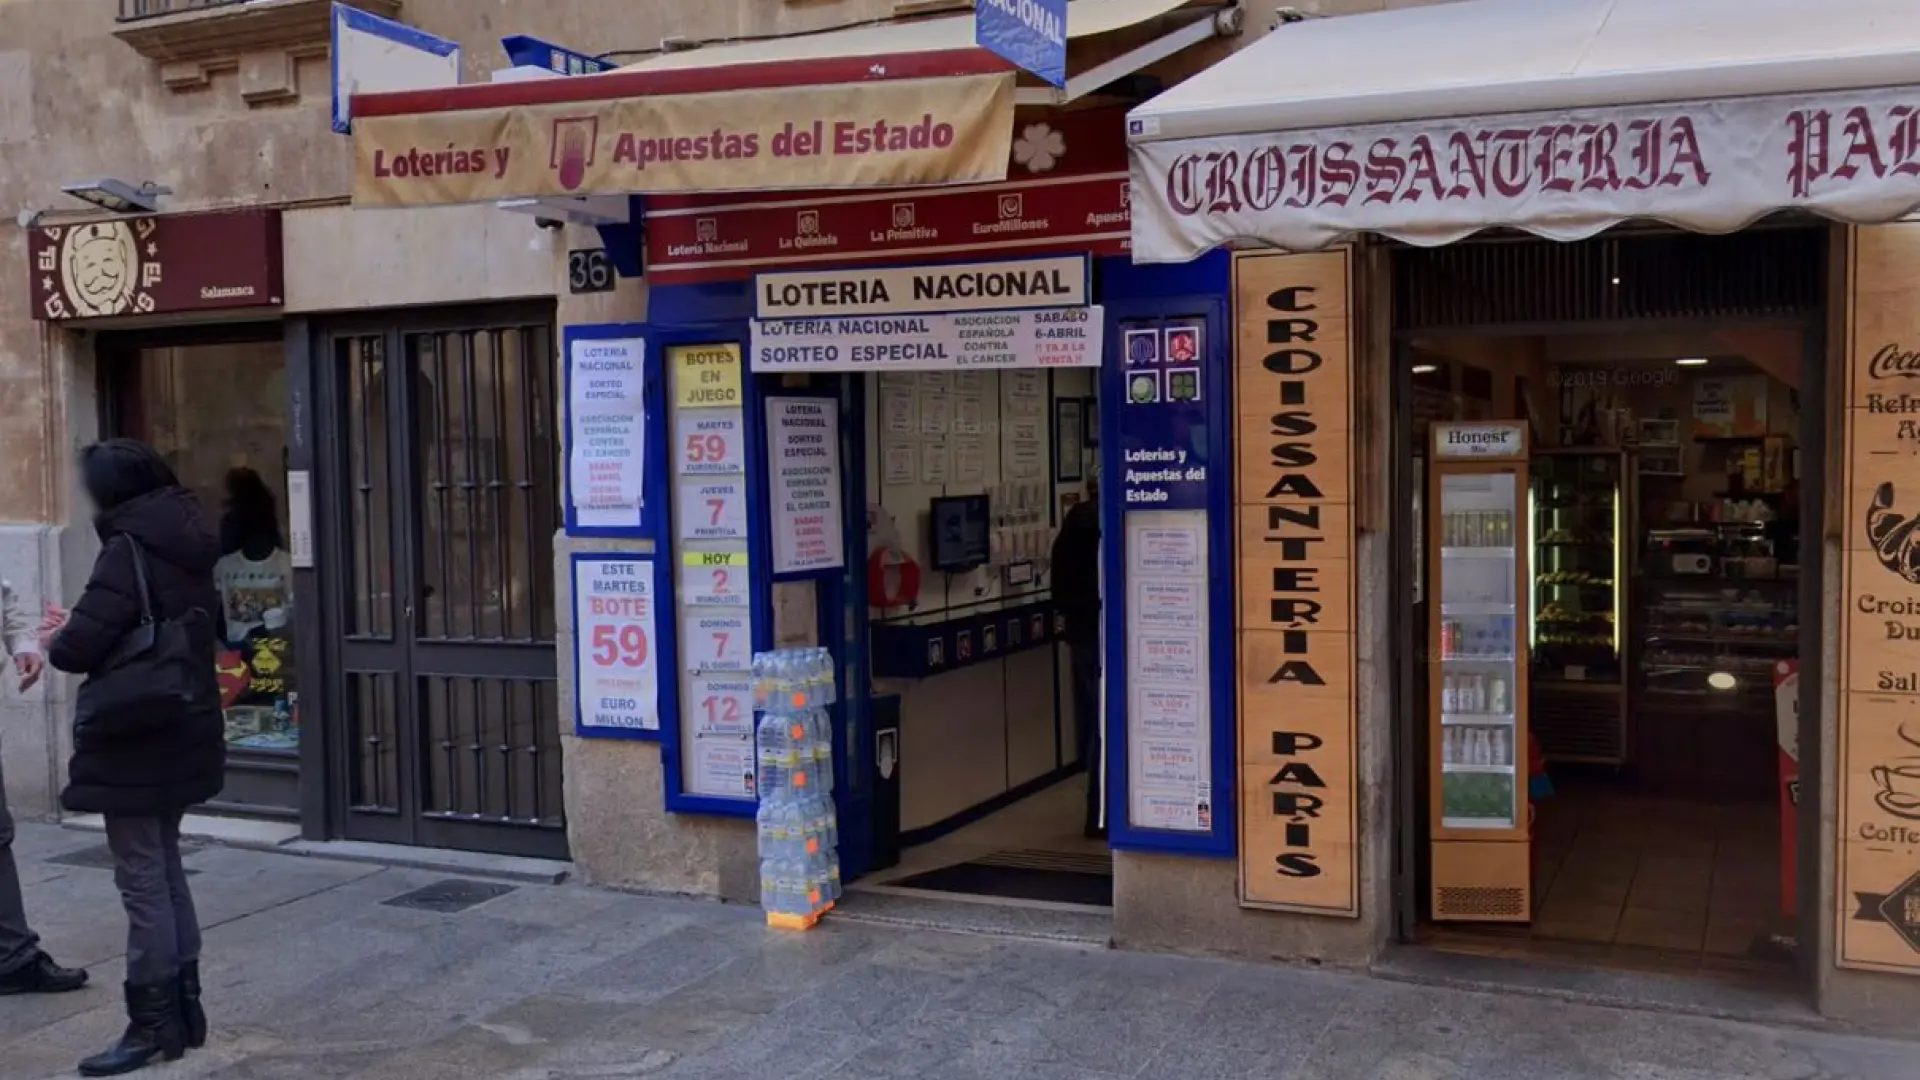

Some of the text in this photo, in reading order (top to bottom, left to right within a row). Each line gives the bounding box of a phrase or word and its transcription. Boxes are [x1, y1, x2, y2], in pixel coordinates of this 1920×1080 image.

[613, 115, 955, 170] Apuestas del Estado
[373, 143, 510, 179] Loterías y
[1167, 114, 1712, 216] CROISSANTERIA
[870, 226, 938, 242] La Primitiva
[972, 217, 1049, 235] EuroMillones
[705, 238, 748, 254] Nacional
[779, 237, 793, 249] La
[571, 252, 608, 288] 36
[200, 285, 255, 299] Salamanca
[766, 269, 1071, 307] LOTERIA NACIONAL
[761, 318, 929, 336] LOTERIA NACIONAL
[959, 327, 1015, 339] ESPAÑOLA
[1035, 327, 1087, 339] 6-ABRIL
[761, 342, 948, 364] SORTEO ESPECIAL
[964, 342, 1009, 352] CONTRA
[686, 351, 734, 366] BOTES
[956, 353, 1016, 365] EL CANCER
[701, 370, 721, 383] EN
[687, 388, 736, 402] JUEGO
[1448, 430, 1510, 444] Honest
[686, 434, 726, 463] 59
[1178, 449, 1187, 464] y
[1126, 466, 1206, 485] Apuestas del
[1126, 488, 1168, 502] Estado
[706, 498, 724, 526] 7
[703, 552, 732, 565] HOY
[602, 563, 635, 576] ESTE
[593, 580, 646, 592] MARTES
[712, 569, 729, 593] 2
[590, 598, 647, 616] BOTE
[591, 624, 648, 667] 59
[712, 632, 730, 659] 7
[600, 697, 636, 711] EURO
[702, 695, 741, 722] 12
[594, 713, 644, 726] MILLON
